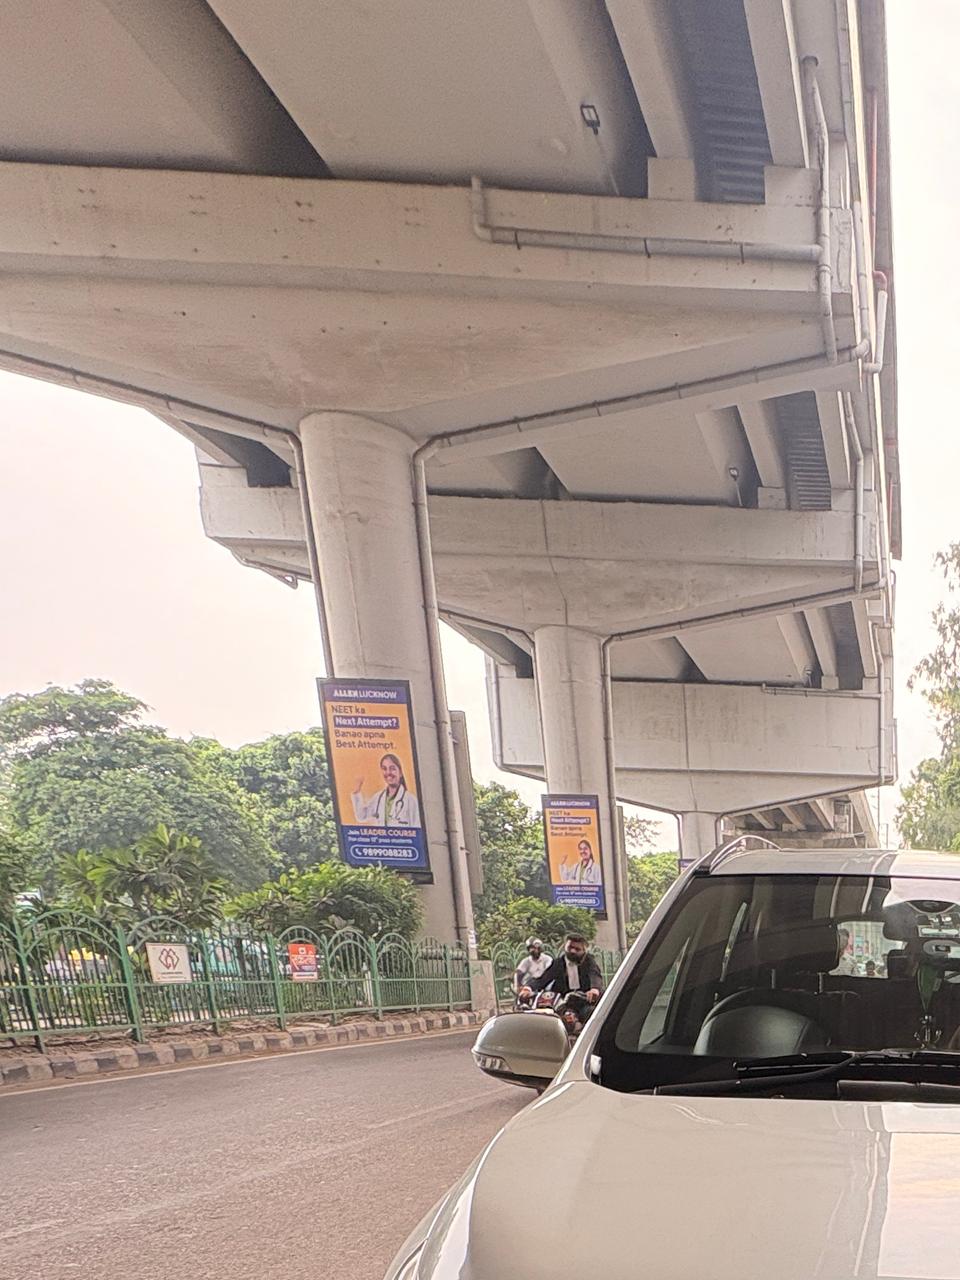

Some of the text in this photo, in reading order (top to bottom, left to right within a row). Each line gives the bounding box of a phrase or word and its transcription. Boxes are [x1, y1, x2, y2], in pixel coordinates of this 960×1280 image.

[333, 689, 397, 699] ALLEN LUCKNOW
[331, 704, 366, 714] NEET ka
[335, 716, 397, 728] Next Attempt?
[334, 729, 386, 739] Banao apna
[336, 739, 356, 748] Best
[360, 828, 387, 837] LEADER
[387, 829, 417, 838] COURSE
